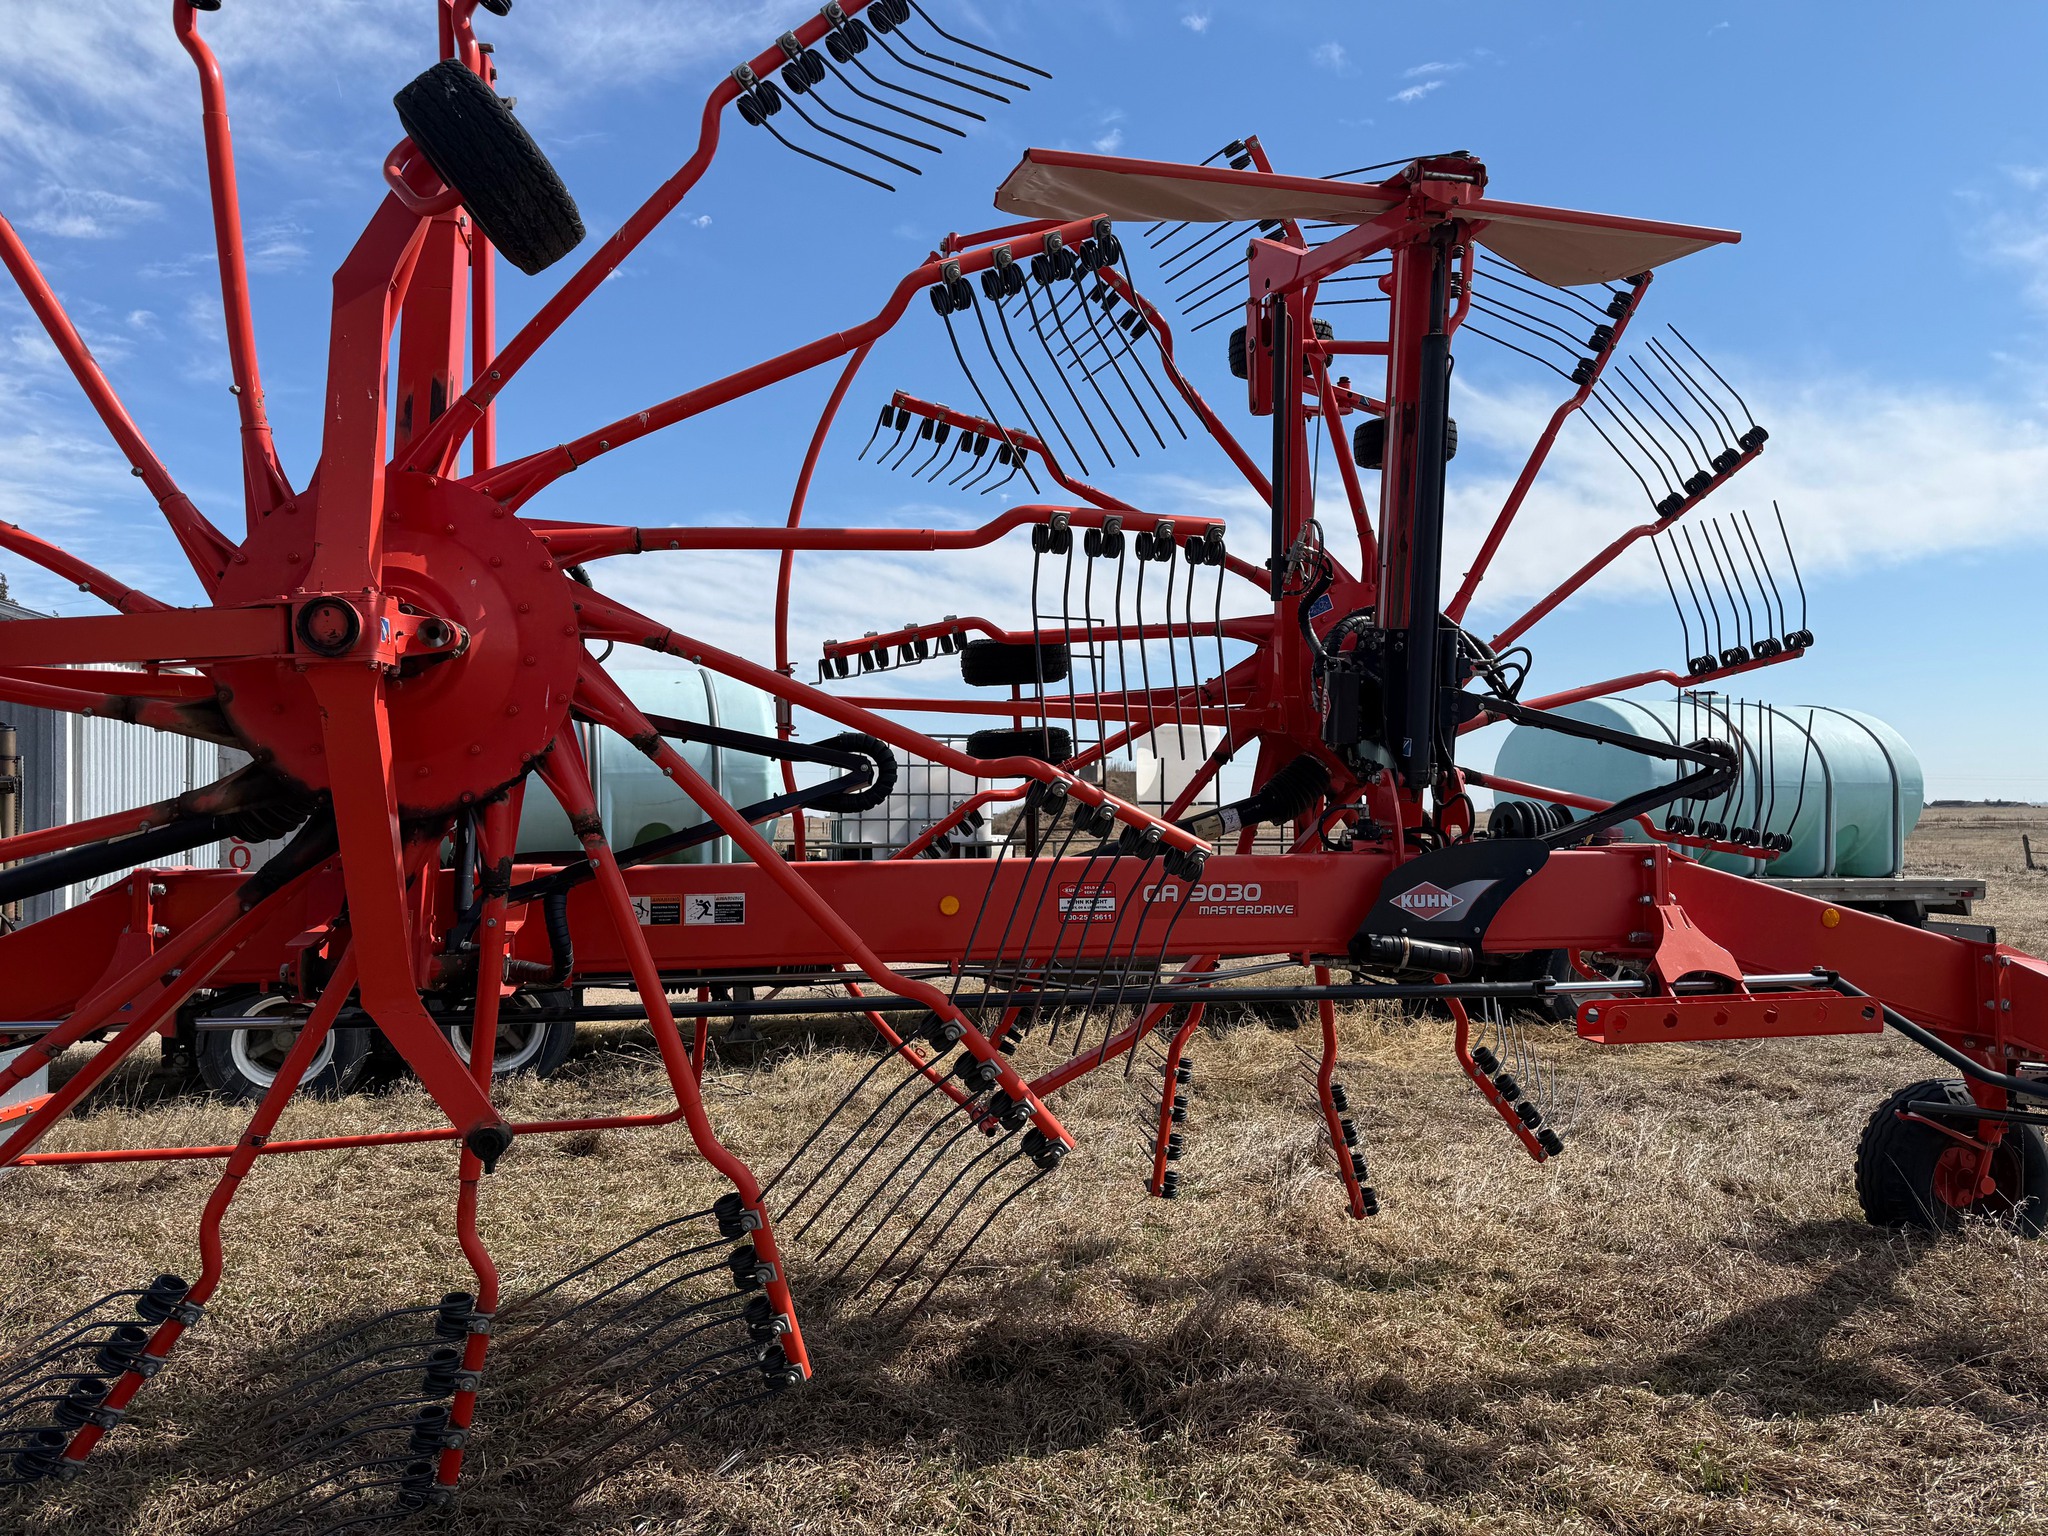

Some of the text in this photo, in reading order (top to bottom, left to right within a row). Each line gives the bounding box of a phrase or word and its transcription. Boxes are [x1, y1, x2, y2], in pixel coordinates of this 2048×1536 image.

[1143, 883, 1262, 902] GA 9030
[1401, 894, 1453, 908] KUHN
[1199, 905, 1294, 915] MASTERDRIVE
